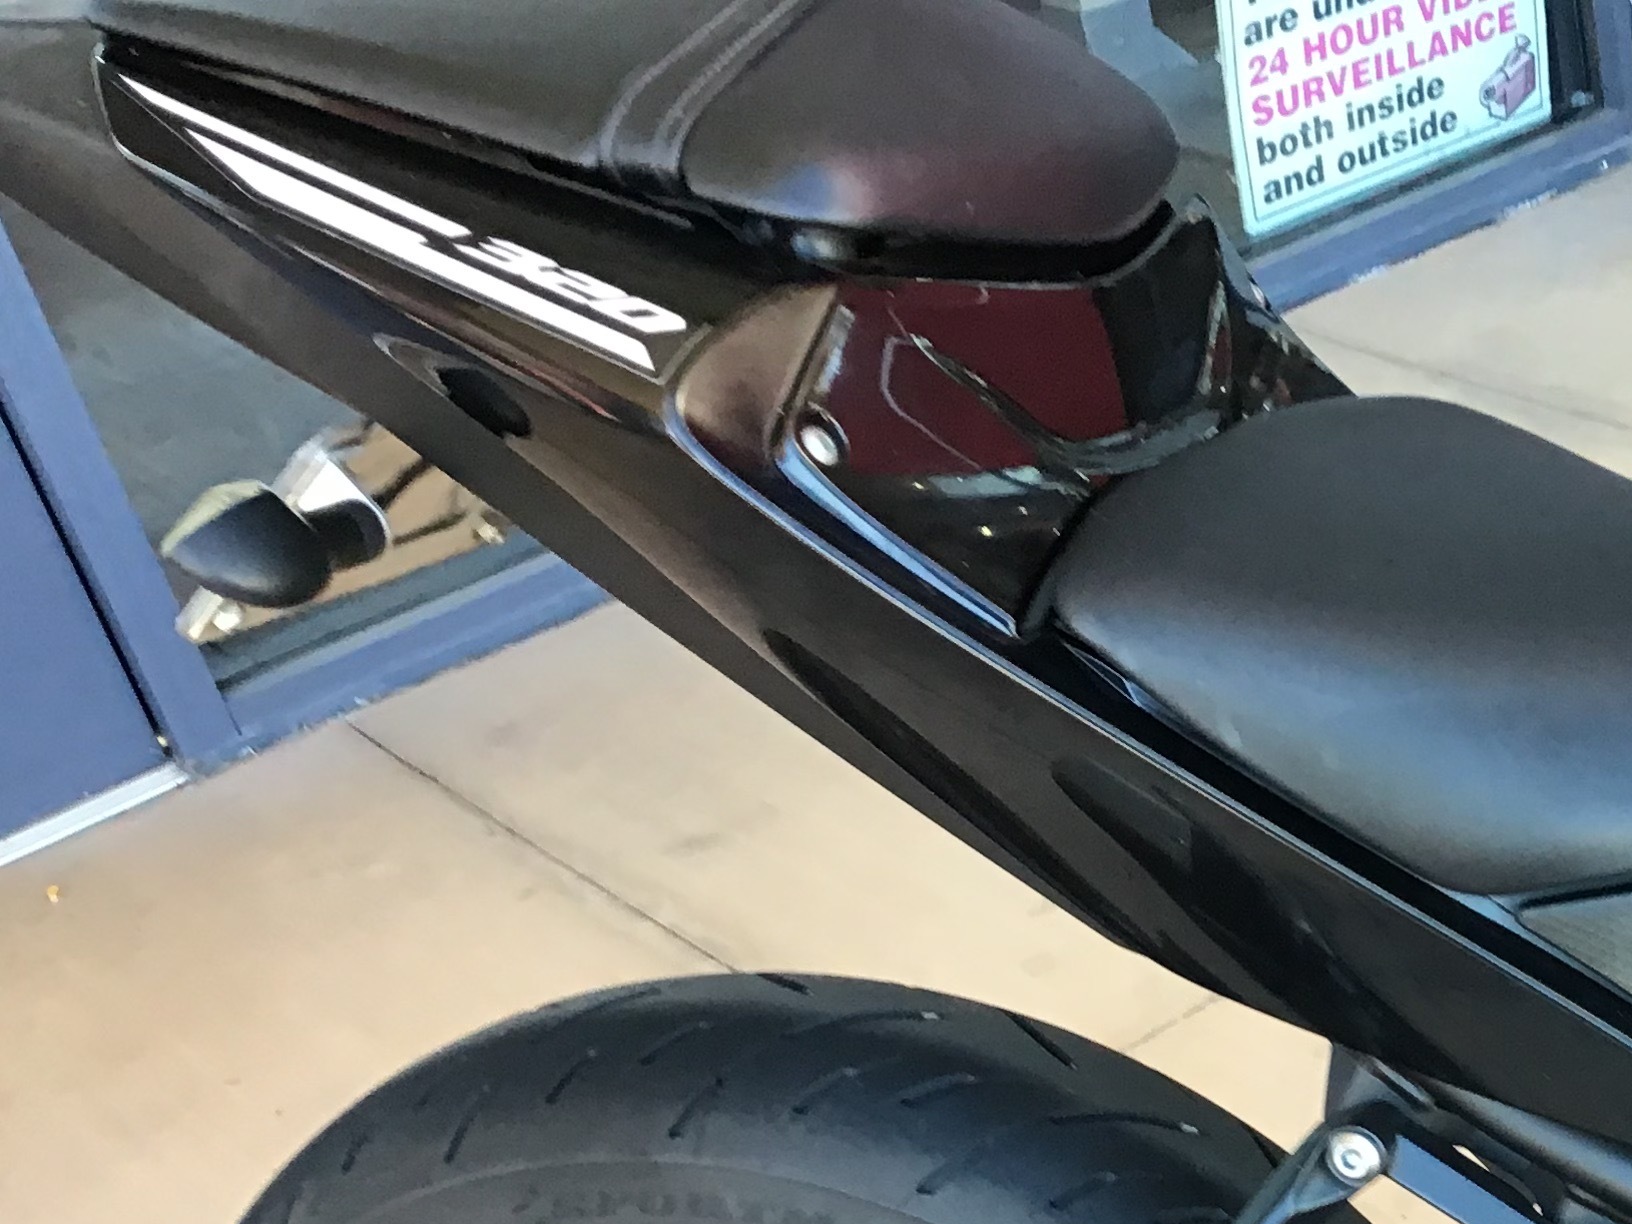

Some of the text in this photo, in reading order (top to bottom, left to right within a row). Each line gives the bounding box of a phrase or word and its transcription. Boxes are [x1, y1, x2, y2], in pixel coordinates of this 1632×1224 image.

[1244, 8, 1299, 46] are
[1248, 47, 1289, 87] 24
[1303, 5, 1404, 66] HOUR
[1251, 2, 1518, 127] SURVEILLANCE
[1257, 76, 1446, 166] both inside
[1264, 108, 1458, 205] and outside
[452, 236, 687, 334] 320
